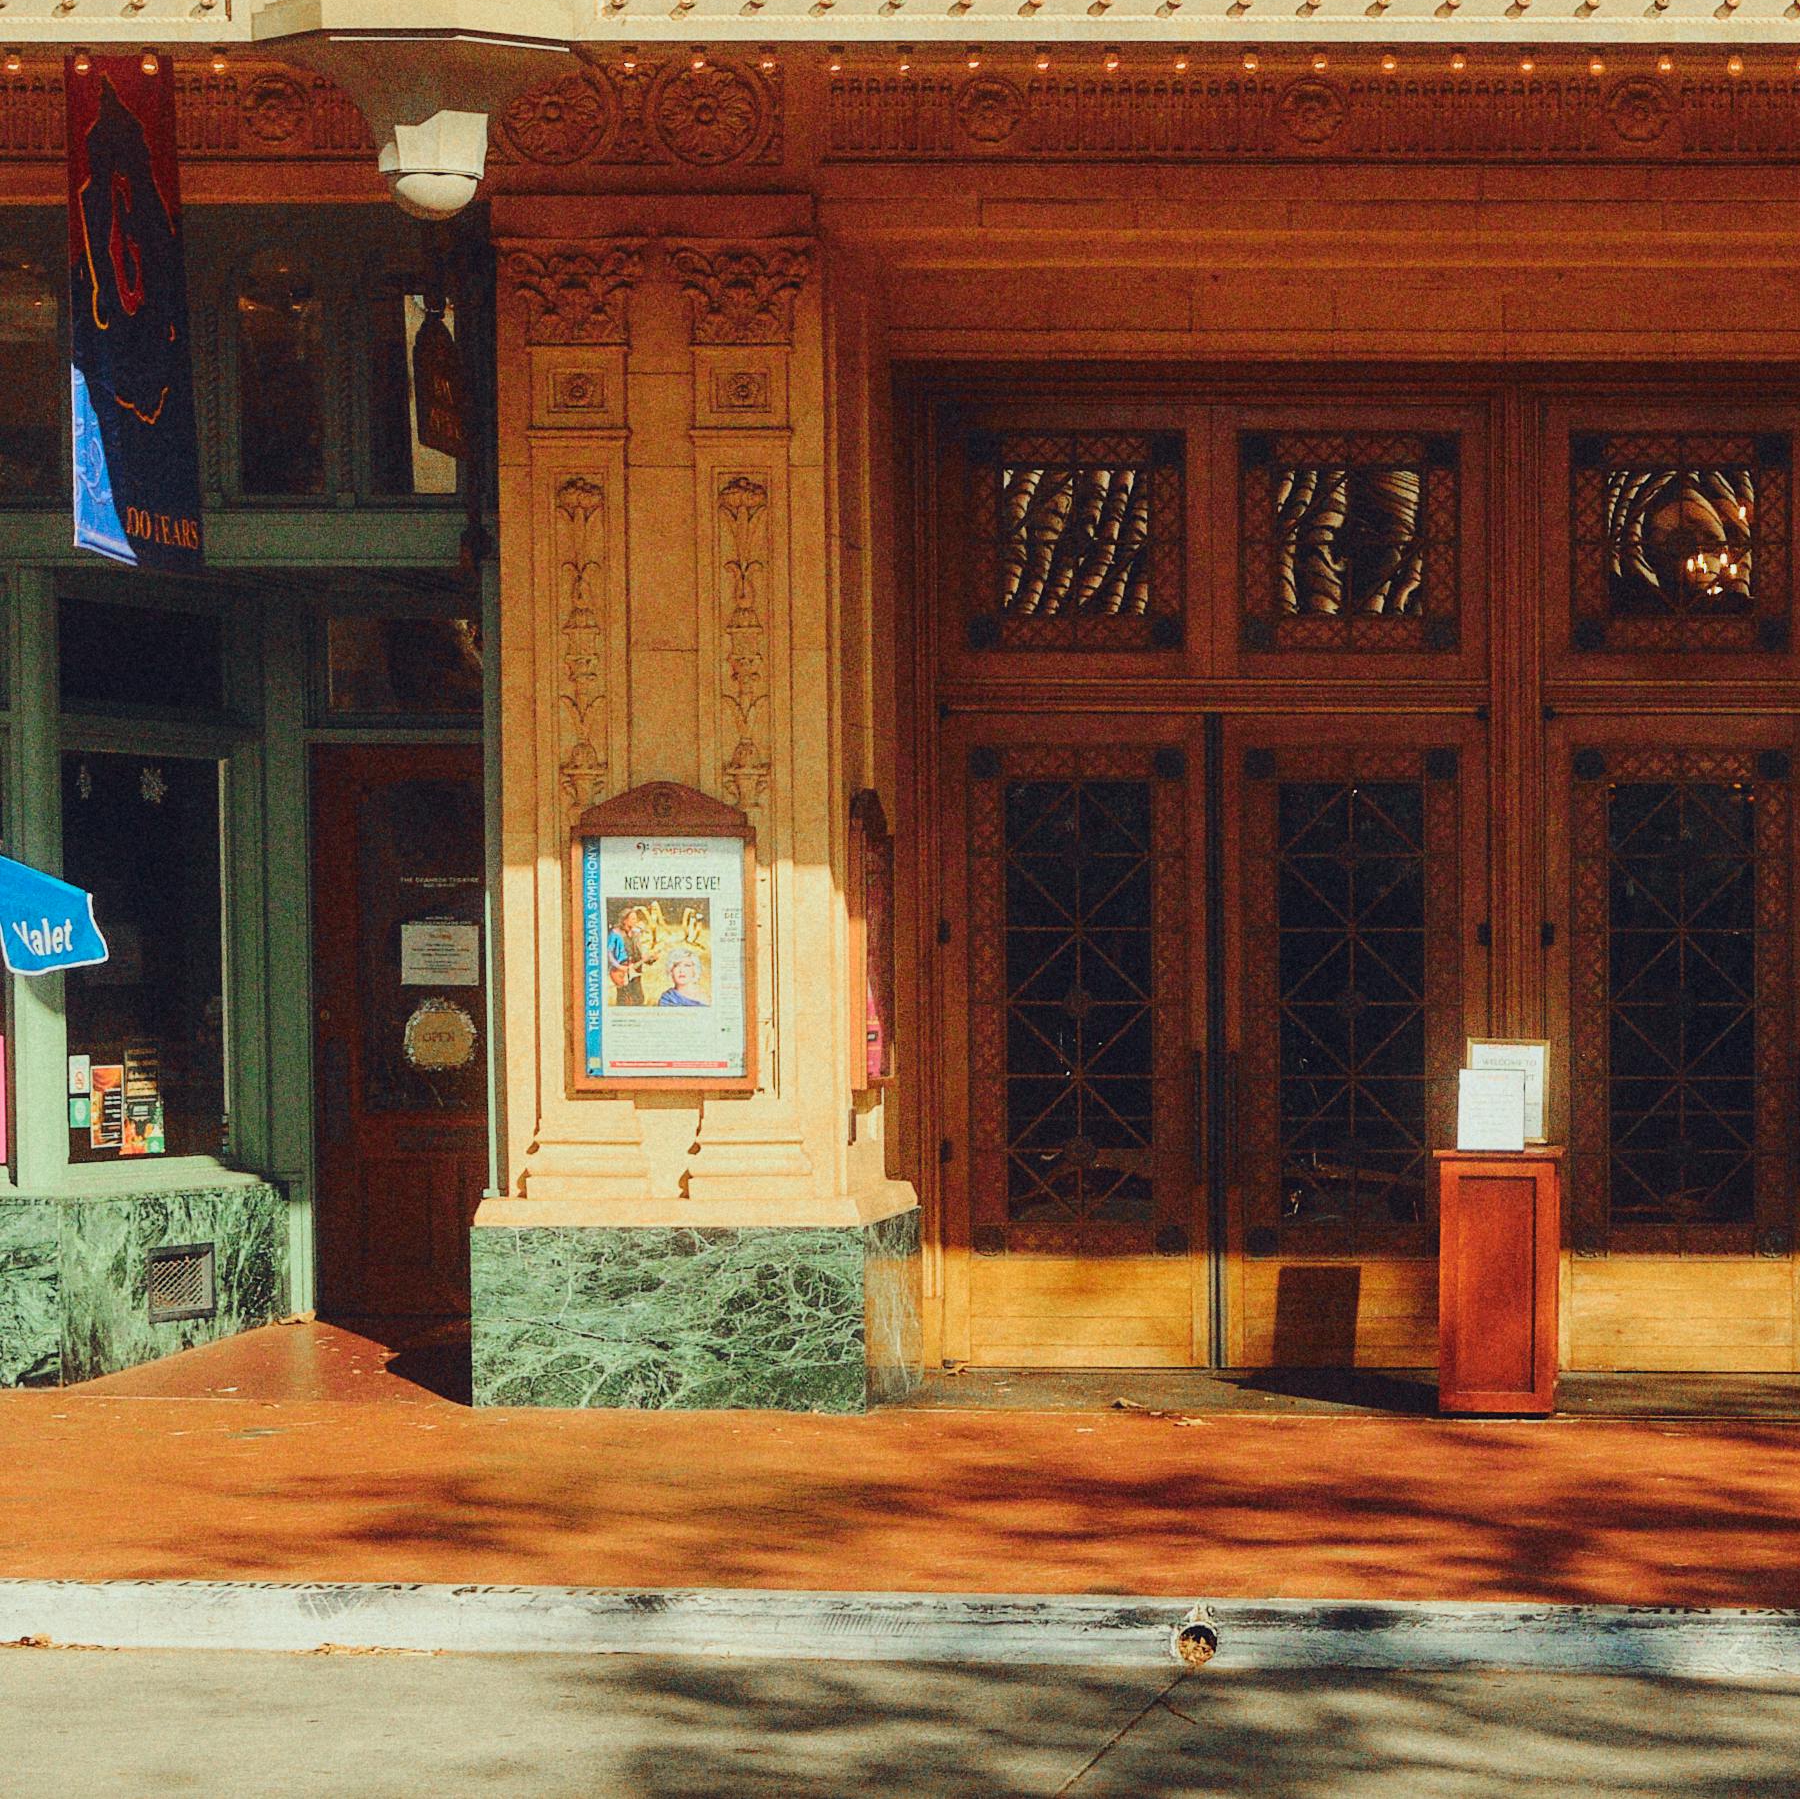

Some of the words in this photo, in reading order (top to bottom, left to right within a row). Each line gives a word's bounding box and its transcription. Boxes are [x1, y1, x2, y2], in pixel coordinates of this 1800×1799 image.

[586, 844, 598, 910] SYMPHONY
[624, 876, 650, 890] NEW
[653, 876, 693, 890] YEAR'S
[696, 876, 721, 890] EVE!
[11, 917, 73, 956] Valet
[587, 912, 599, 967] BARBARA
[588, 969, 599, 1007] SANTA
[588, 1009, 599, 1031] THE
[1627, 1607, 1711, 1615] MIN
